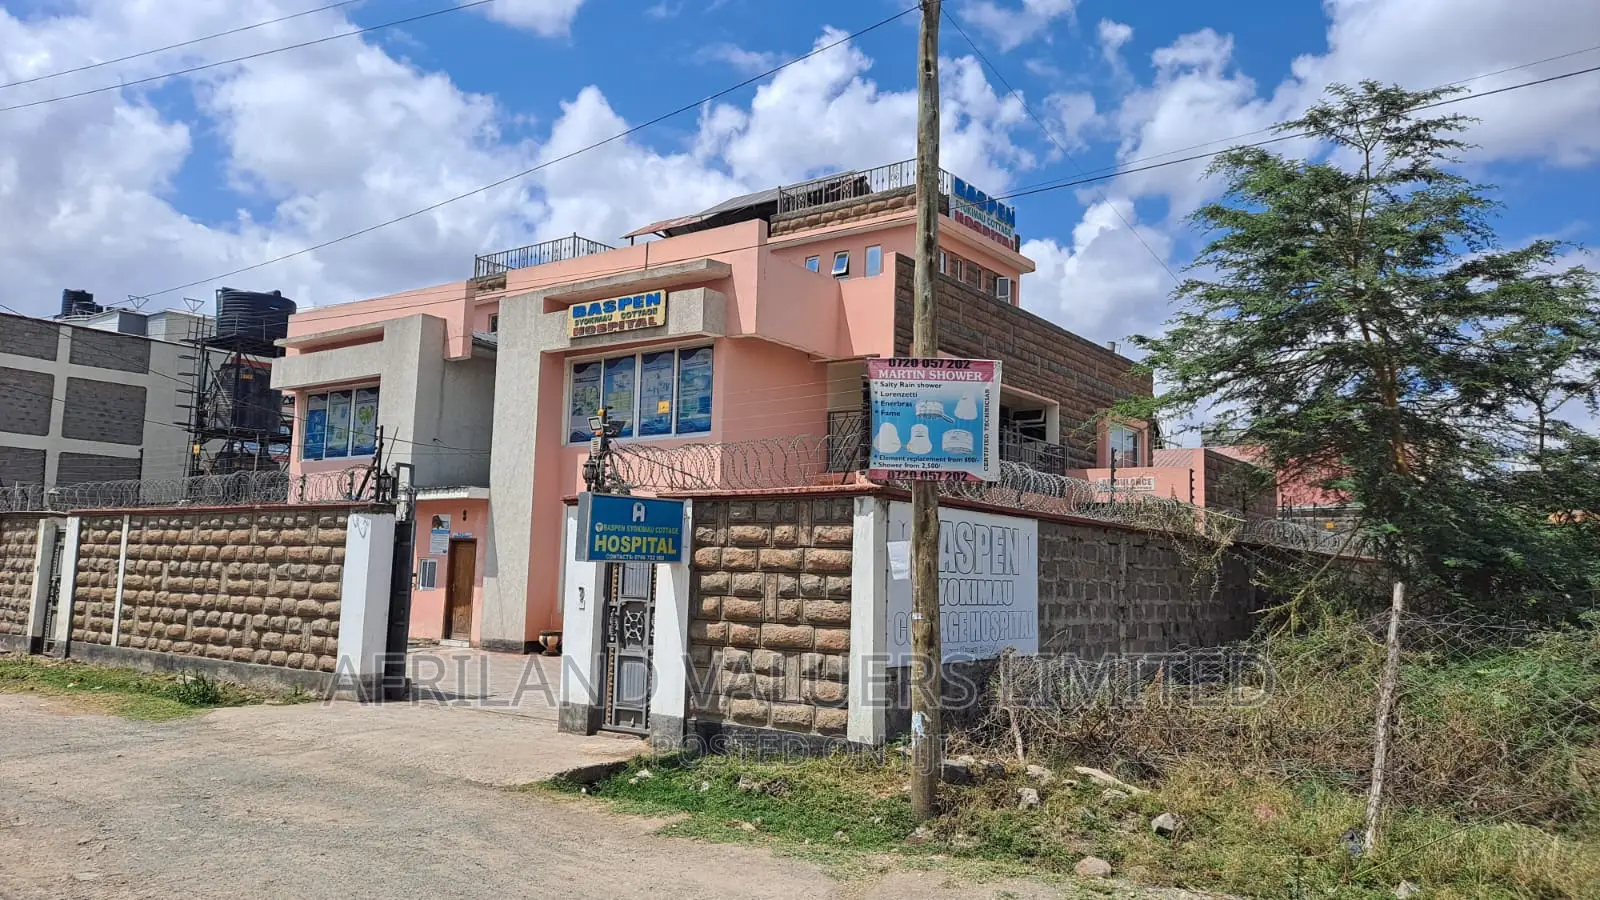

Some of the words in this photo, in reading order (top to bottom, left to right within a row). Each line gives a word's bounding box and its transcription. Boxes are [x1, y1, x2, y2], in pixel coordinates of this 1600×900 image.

[572, 292, 661, 318] BASPEN
[620, 307, 658, 320] COTTAGE
[573, 316, 657, 337] HOSPITAL
[888, 358, 919, 369] 0720
[921, 359, 945, 369] 057
[946, 360, 971, 370] 202
[878, 369, 926, 380] MARTIN
[929, 370, 983, 381] SHOWER
[906, 455, 946, 463] replacement
[887, 470, 917, 480] 0720
[920, 470, 942, 481] 057
[945, 471, 968, 482] 202
[655, 526, 679, 535] COTTAGE
[594, 534, 677, 554] HOSPITAL
[938, 519, 1020, 576] ASPEN
